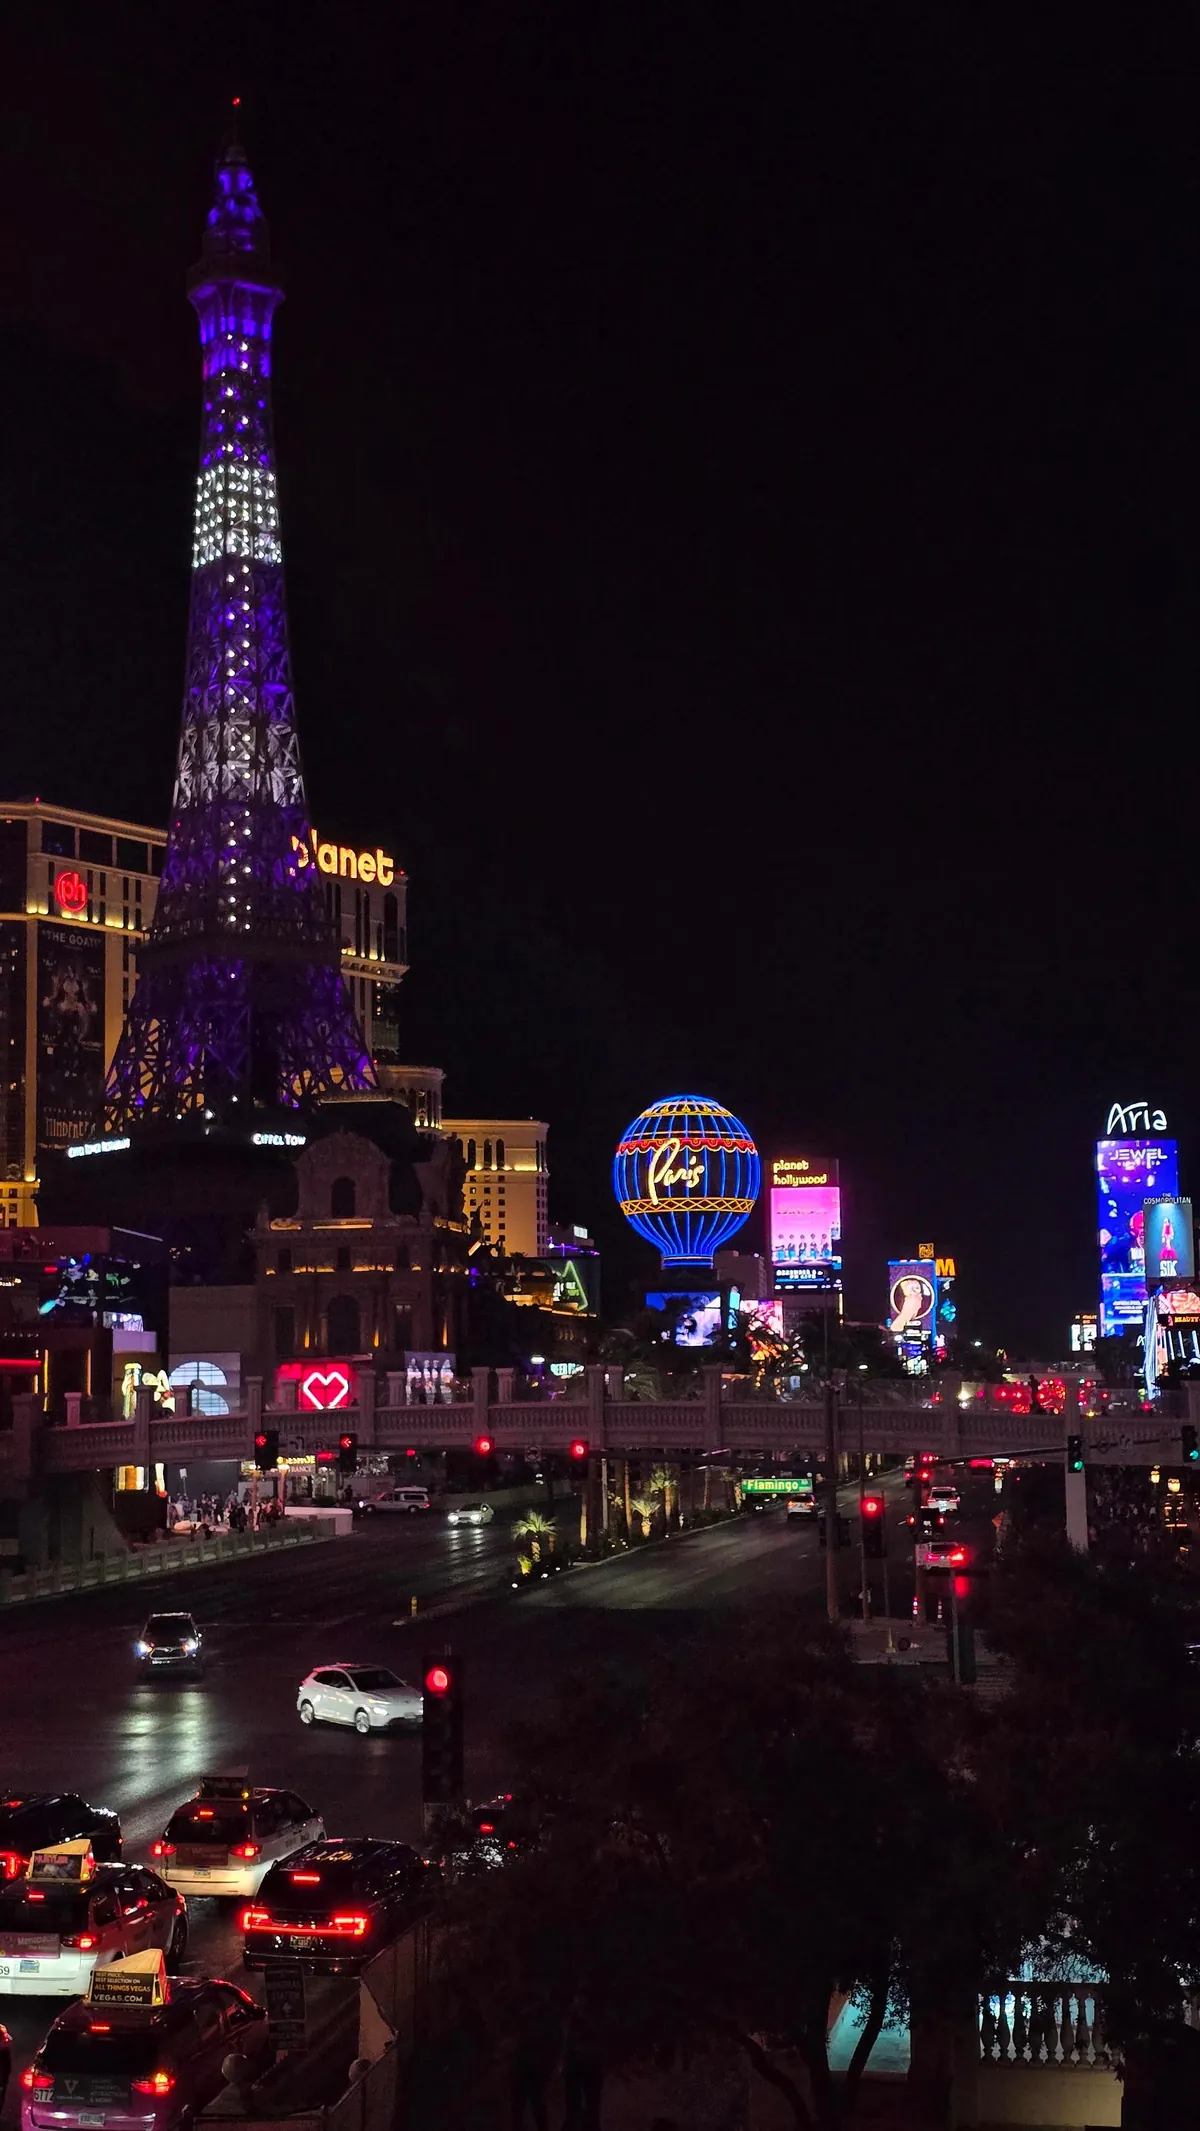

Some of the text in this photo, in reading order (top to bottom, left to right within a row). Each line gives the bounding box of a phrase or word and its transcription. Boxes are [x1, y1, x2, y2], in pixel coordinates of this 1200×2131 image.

[1107, 1102, 1167, 1135] Aria
[1109, 1148, 1168, 1161] JEWEL
[648, 1137, 705, 1206] Paris
[773, 1159, 809, 1174] planet
[773, 1173, 827, 1187] hollywood
[1143, 1196, 1191, 1205] COSMOPOLITAN
[747, 1480, 799, 1492] Flamingo
[107, 1984, 130, 1992] THINGS
[93, 1994, 143, 2003] VEGAS.COM
